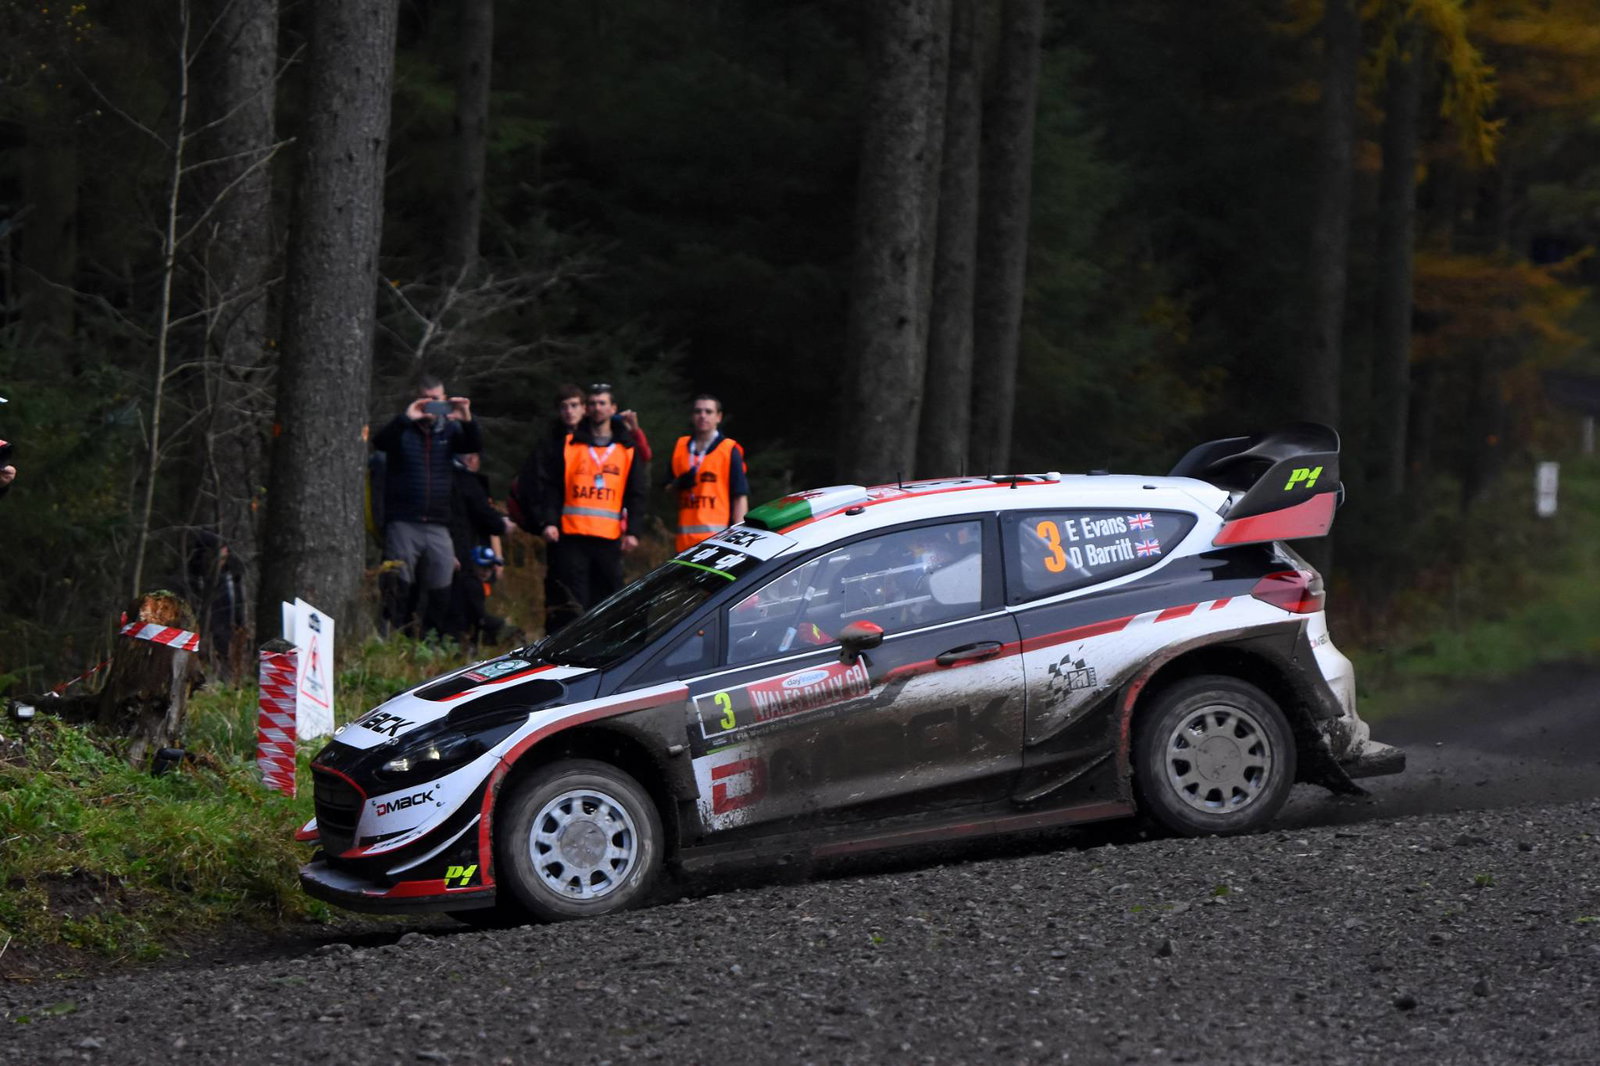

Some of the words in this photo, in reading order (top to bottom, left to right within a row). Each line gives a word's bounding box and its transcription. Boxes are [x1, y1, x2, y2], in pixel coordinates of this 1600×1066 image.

[1284, 466, 1323, 490] P1
[1065, 520, 1079, 541] E
[1080, 517, 1127, 539] Evans
[1037, 520, 1066, 573] 3
[1069, 547, 1083, 569] D
[1086, 537, 1134, 566] Barritt
[714, 692, 736, 729] 3
[752, 688, 802, 719] WALES
[804, 674, 845, 710] RALLY
[711, 696, 1010, 815] DMCK
[444, 864, 478, 886] P1
